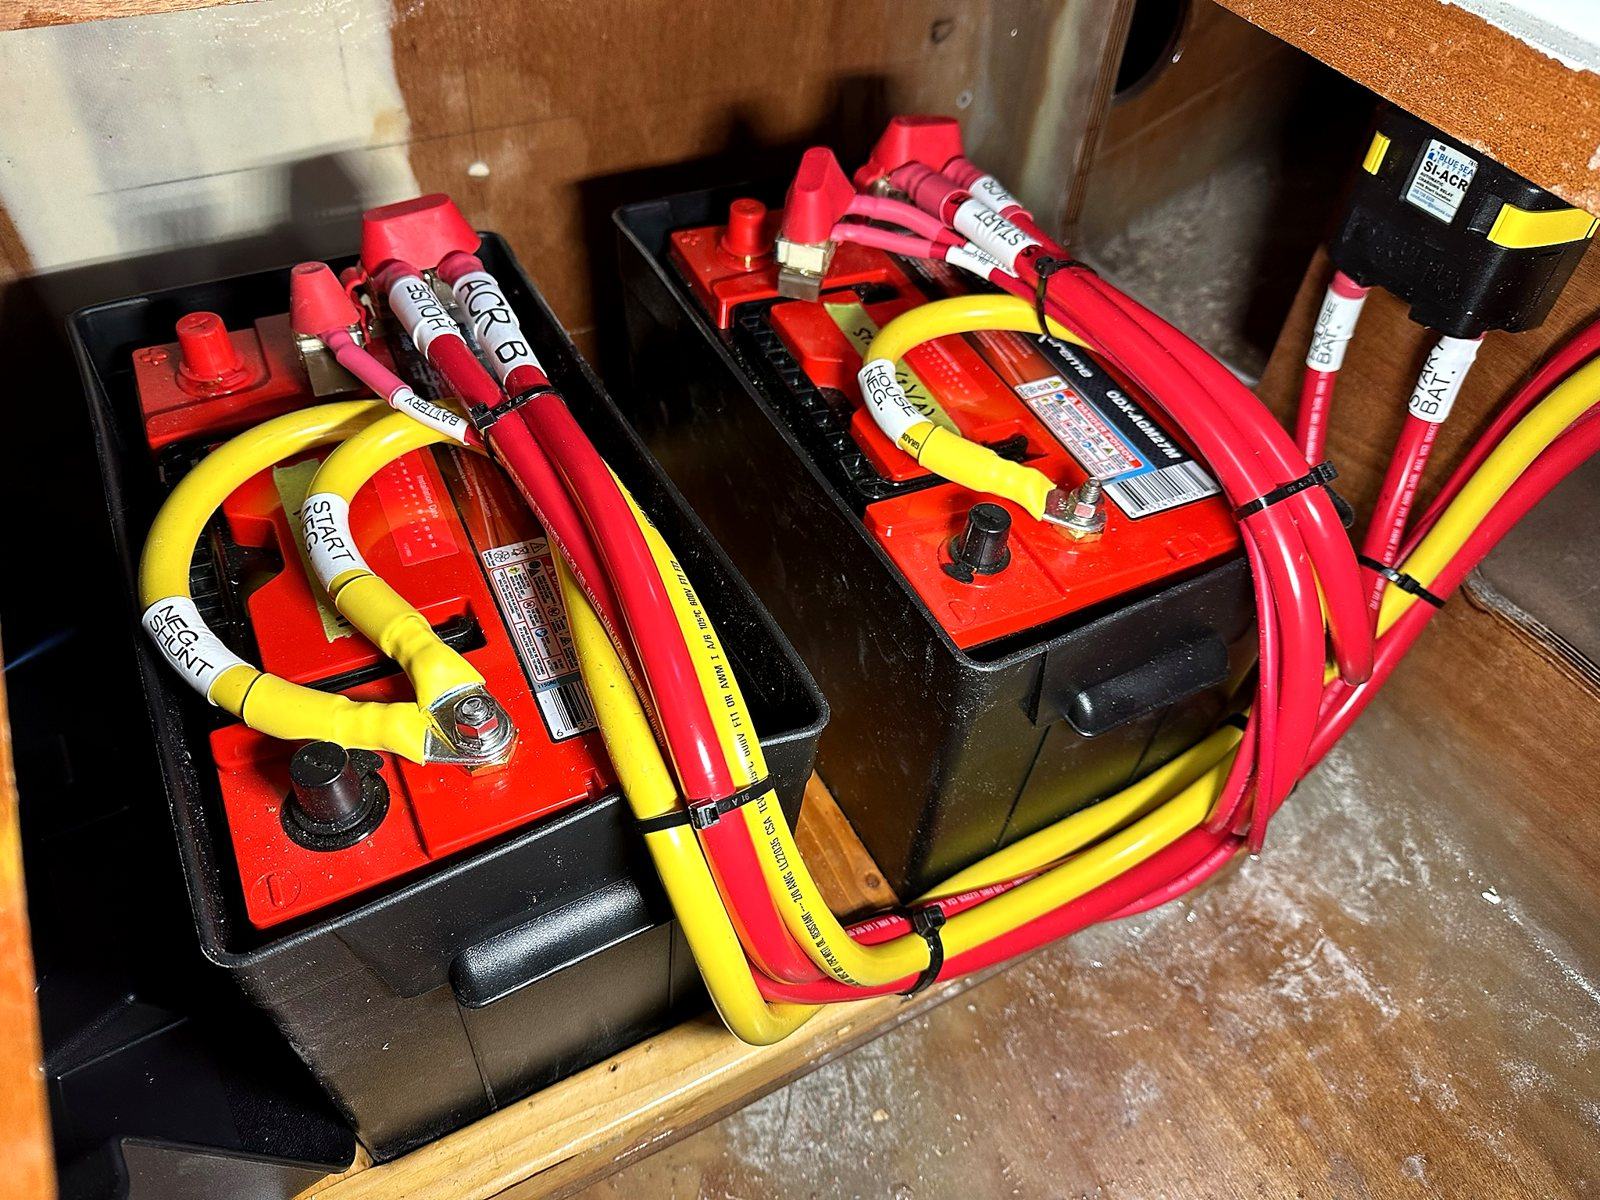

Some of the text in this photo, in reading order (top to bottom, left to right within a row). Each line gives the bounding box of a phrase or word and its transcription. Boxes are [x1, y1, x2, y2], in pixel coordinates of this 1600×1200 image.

[1423, 160, 1470, 193] SI-ACR
[1438, 153, 1474, 176] BLUE SEA
[982, 180, 1009, 201] ACR
[973, 209, 1026, 246] START
[406, 284, 450, 330] HOUSE
[459, 280, 511, 336] ACR
[495, 341, 528, 364] B
[1316, 325, 1342, 364] BAT.
[864, 368, 887, 411] NEG.
[874, 365, 916, 417] HOUSE
[1420, 370, 1456, 415] BAT.
[404, 396, 460, 426] BATTERY
[1105, 389, 1183, 460] ODX-AGM27M
[416, 474, 433, 503] Installation
[300, 505, 319, 561] NEG.
[313, 500, 356, 561] START
[149, 614, 214, 677] SHUNT
[159, 605, 199, 651] NEG.
[703, 634, 716, 650] A/B
[714, 664, 730, 689] AWM
[725, 694, 736, 708] OR
[556, 728, 564, 737] 6
[730, 711, 742, 728] FT1
[763, 816, 776, 836] CSA
[783, 871, 798, 890] AWG
